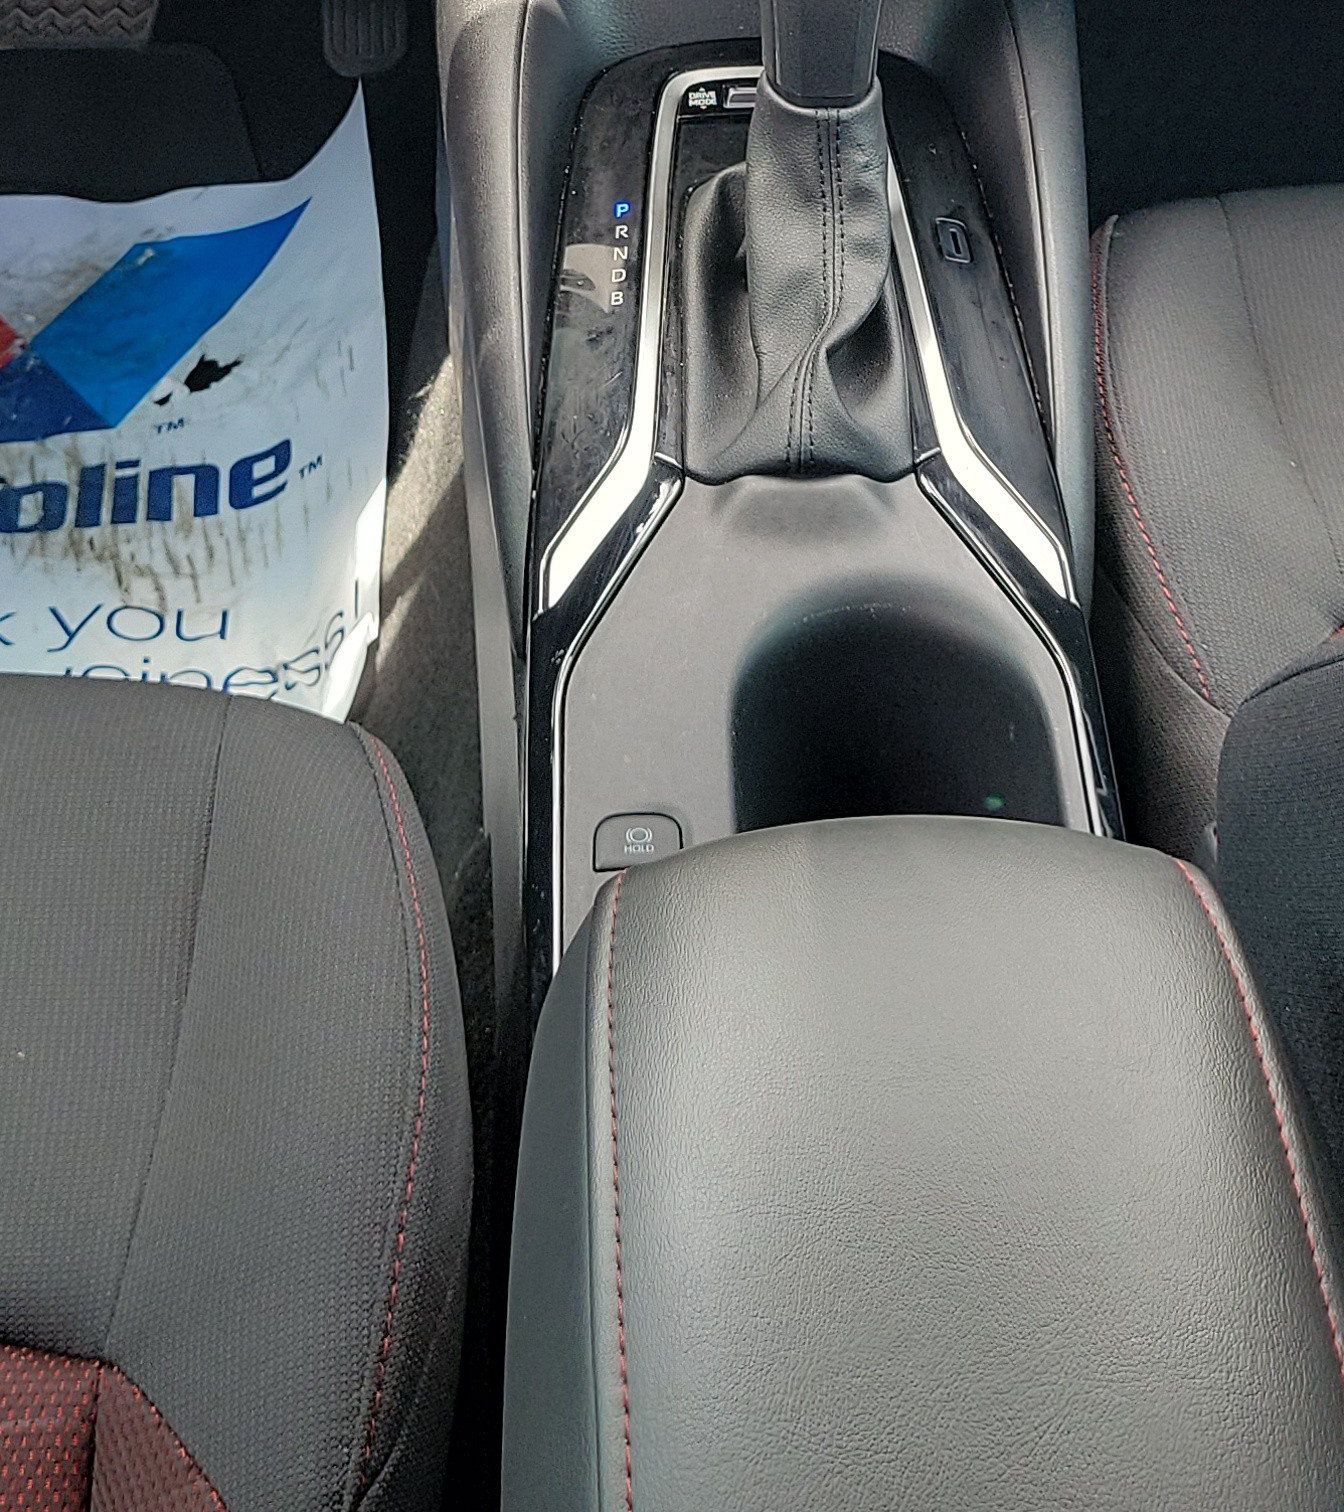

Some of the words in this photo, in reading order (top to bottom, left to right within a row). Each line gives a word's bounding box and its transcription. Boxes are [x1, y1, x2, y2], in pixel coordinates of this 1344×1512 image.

[688, 98, 718, 108] MODE
[615, 202, 631, 219] P
[614, 224, 630, 240] R
[613, 245, 629, 261] N
[611, 268, 627, 284] D
[610, 291, 625, 306] B
[48, 603, 228, 653] you
[623, 843, 655, 854] HOLD
